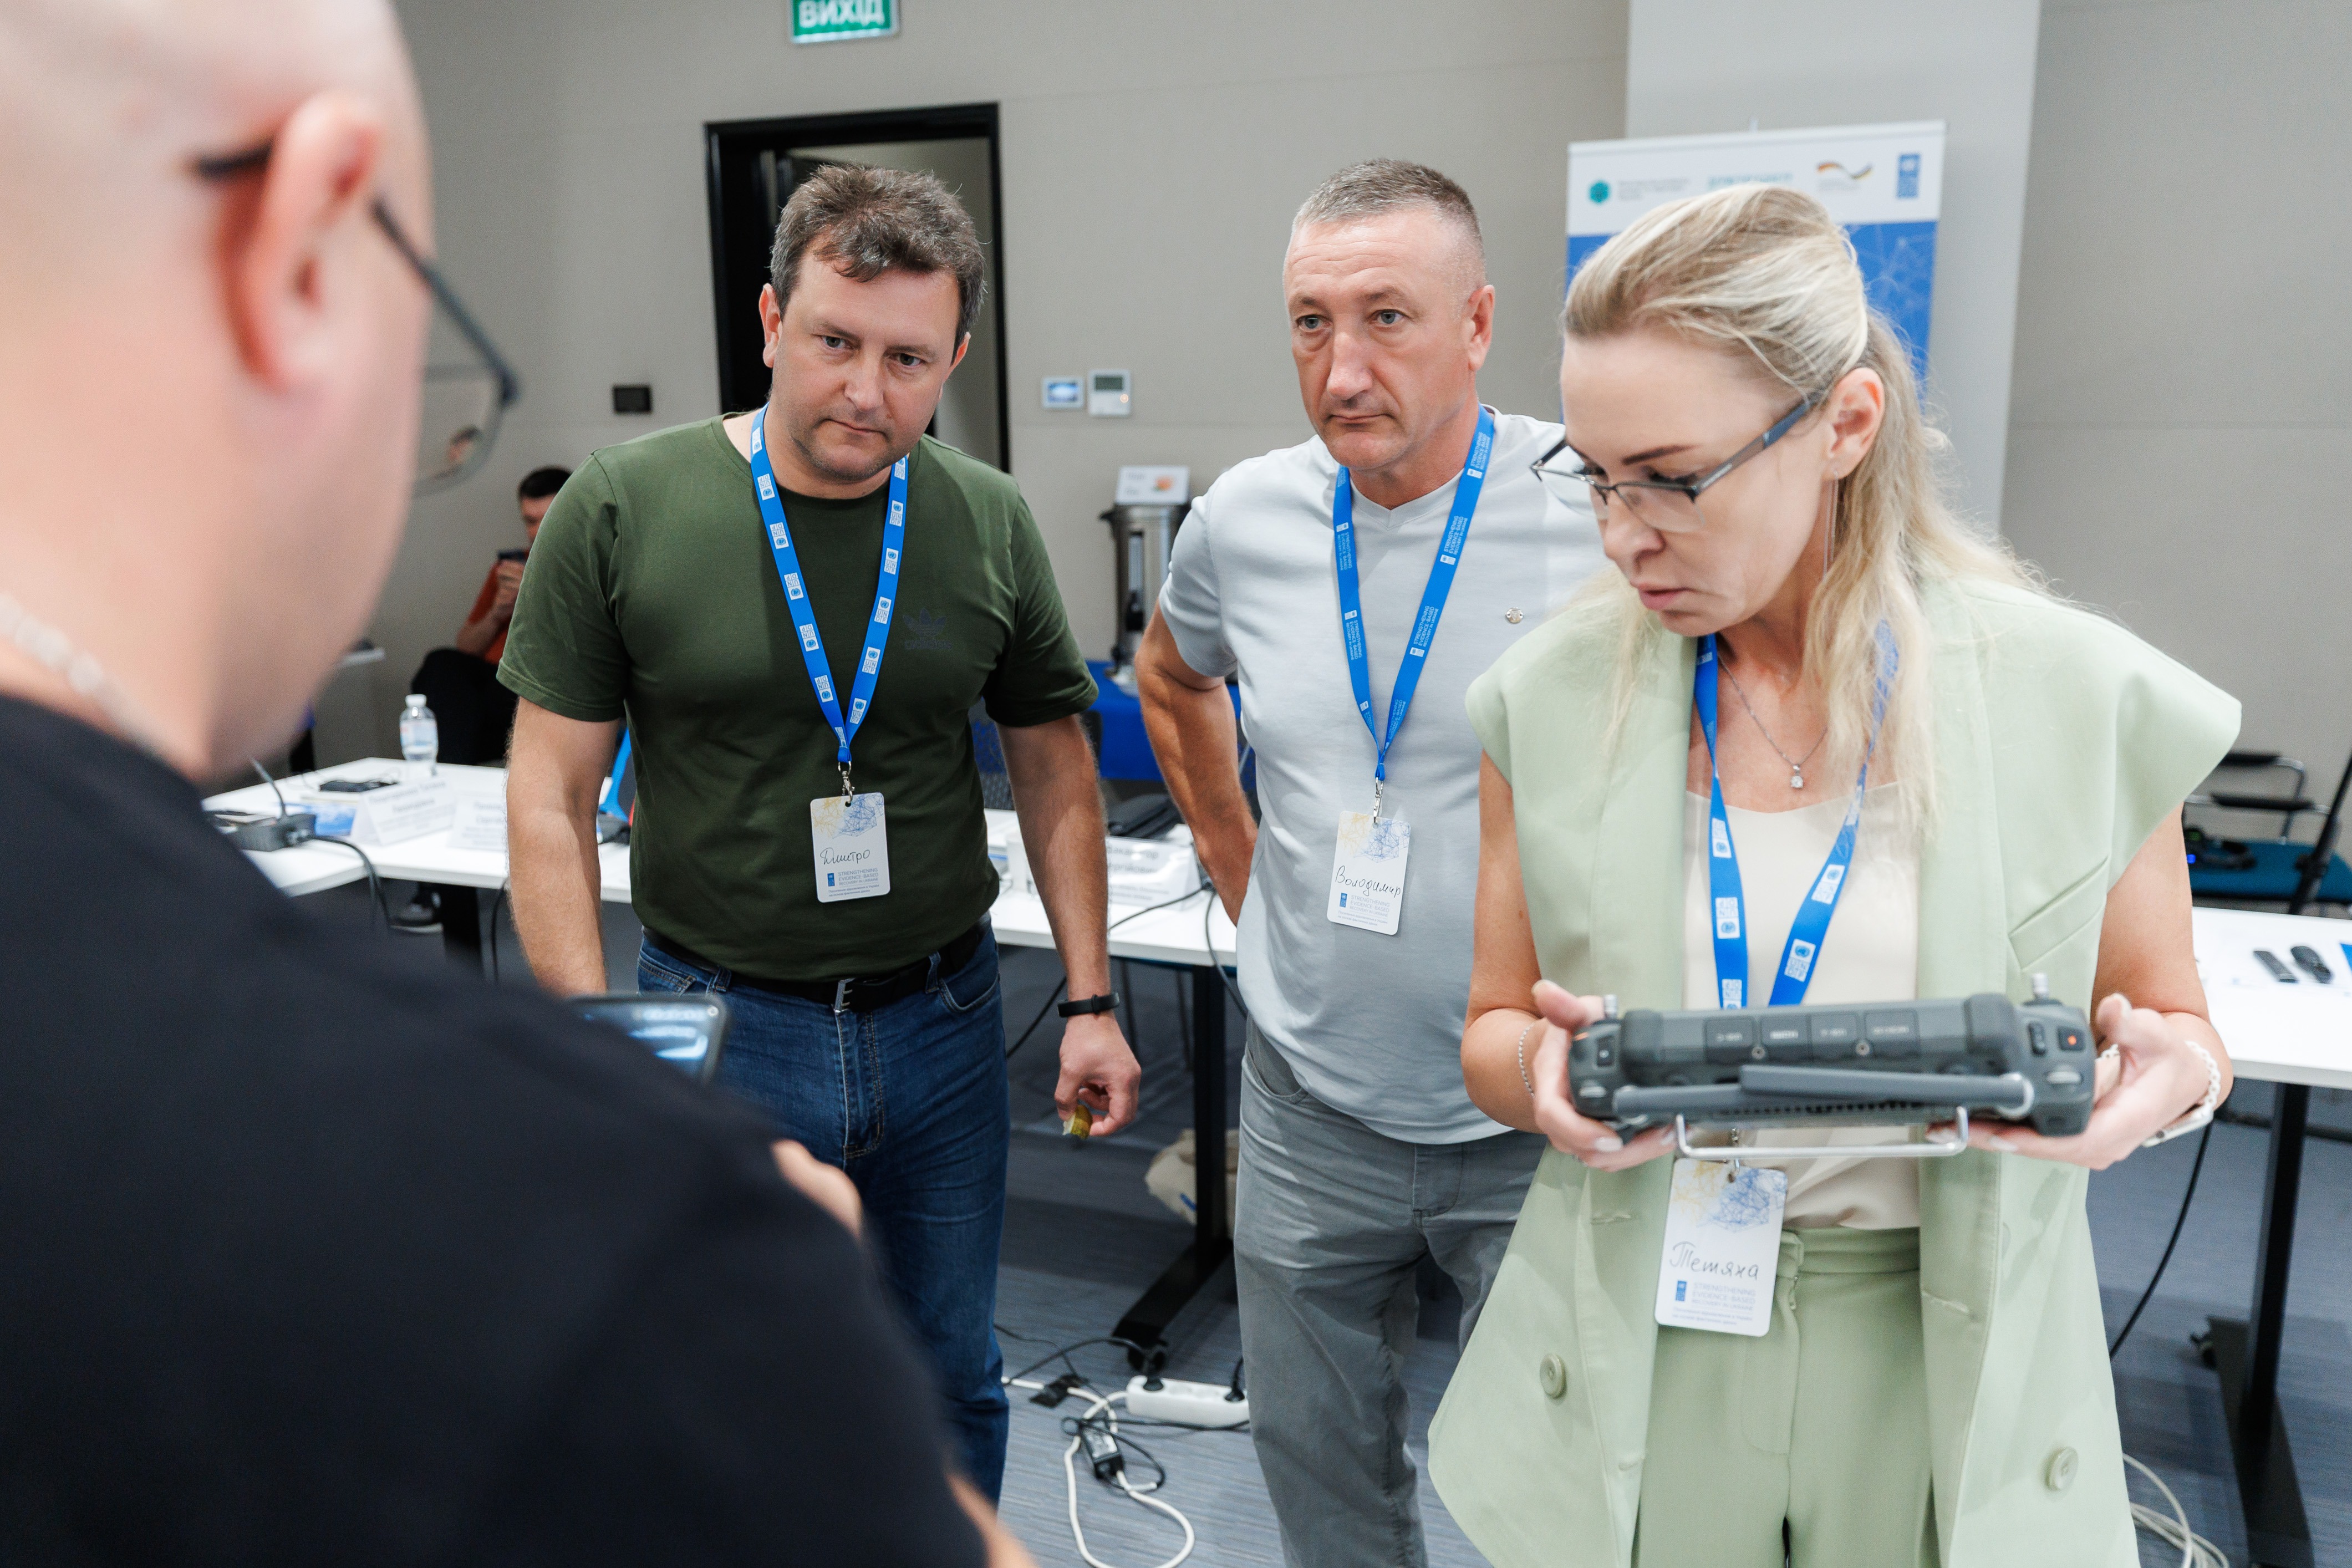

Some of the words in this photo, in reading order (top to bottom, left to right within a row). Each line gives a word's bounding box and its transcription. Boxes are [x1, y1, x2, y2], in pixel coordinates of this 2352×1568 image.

[799, 0, 885, 28] ВИХІД
[1444, 516, 1459, 552] STRENGTHENING
[1354, 620, 1362, 658] STRENGTHENING
[1414, 605, 1429, 644] STRENGTHENING
[1423, 628, 1432, 647] RECOVERY
[820, 847, 870, 865] Дмитро
[838, 868, 878, 876] STRENGTHENING
[1335, 865, 1401, 898] Володимир
[1351, 895, 1390, 907] STRENGTHENING
[1669, 1241, 1759, 1280] Тетяна
